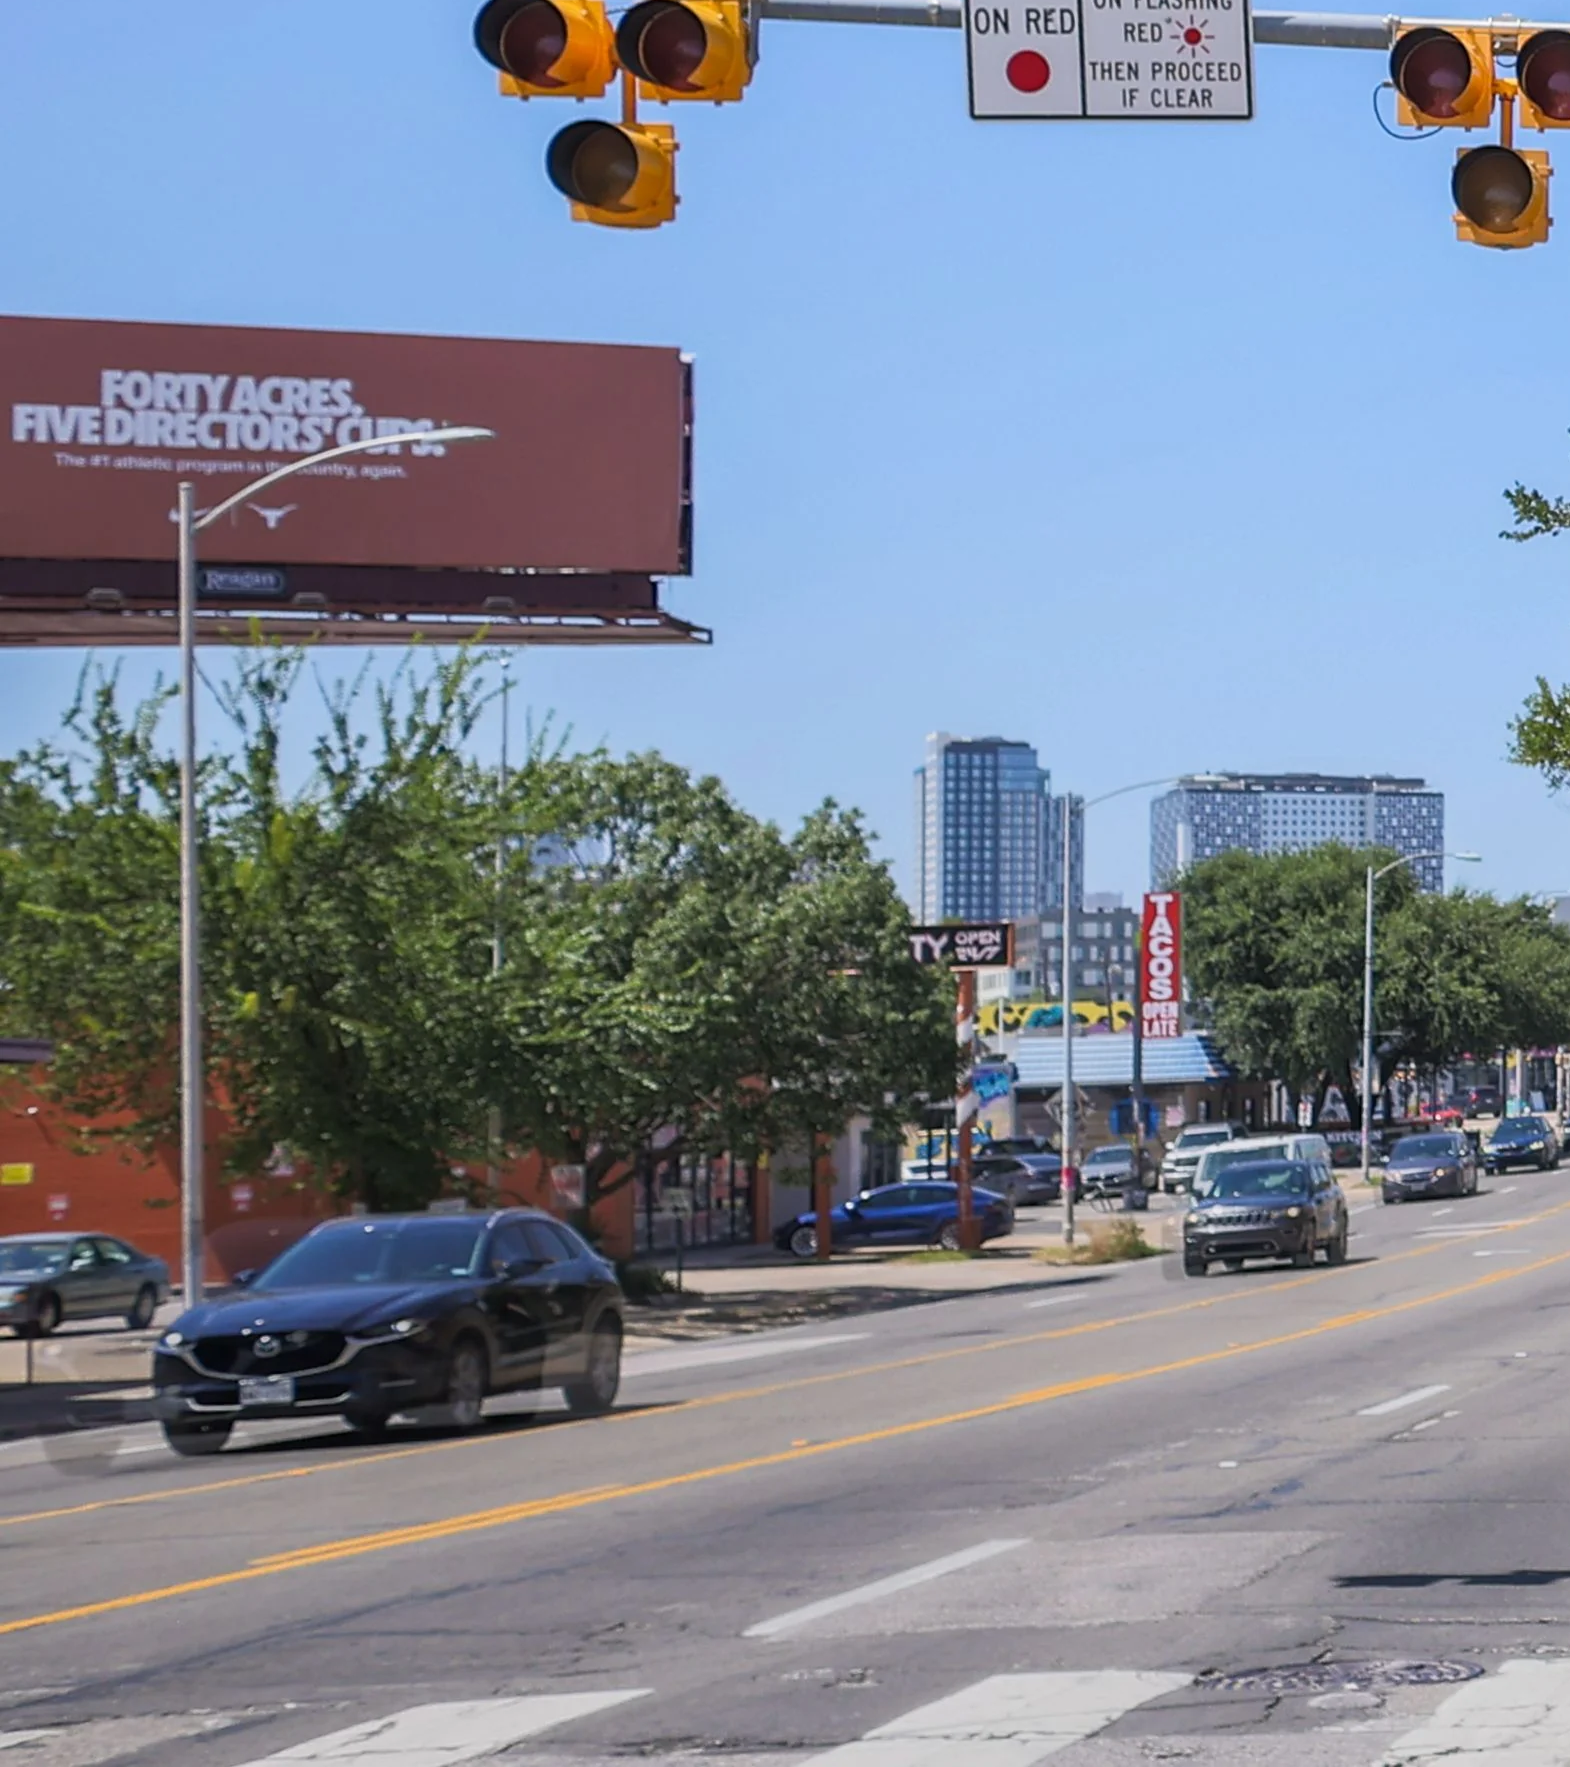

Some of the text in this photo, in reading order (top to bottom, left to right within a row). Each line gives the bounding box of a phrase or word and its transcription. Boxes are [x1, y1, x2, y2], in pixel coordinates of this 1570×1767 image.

[974, 8, 1076, 35] ON RED
[1124, 22, 1163, 43] RED
[1089, 62, 1242, 82] THEN PROCEED
[1121, 88, 1214, 108] IF CLEAR
[101, 368, 364, 418] FORTY ACRES.
[12, 402, 101, 444] FIVE
[104, 408, 333, 453] DIRECTORS'
[54, 451, 86, 468] The
[90, 454, 111, 467] #1
[113, 456, 174, 472] athletic
[176, 459, 245, 476] program
[954, 930, 1001, 945] OPEN
[1148, 894, 1174, 1001] TACOS
[1142, 1001, 1179, 1019] OPEN
[1142, 1019, 1178, 1038] LATE
